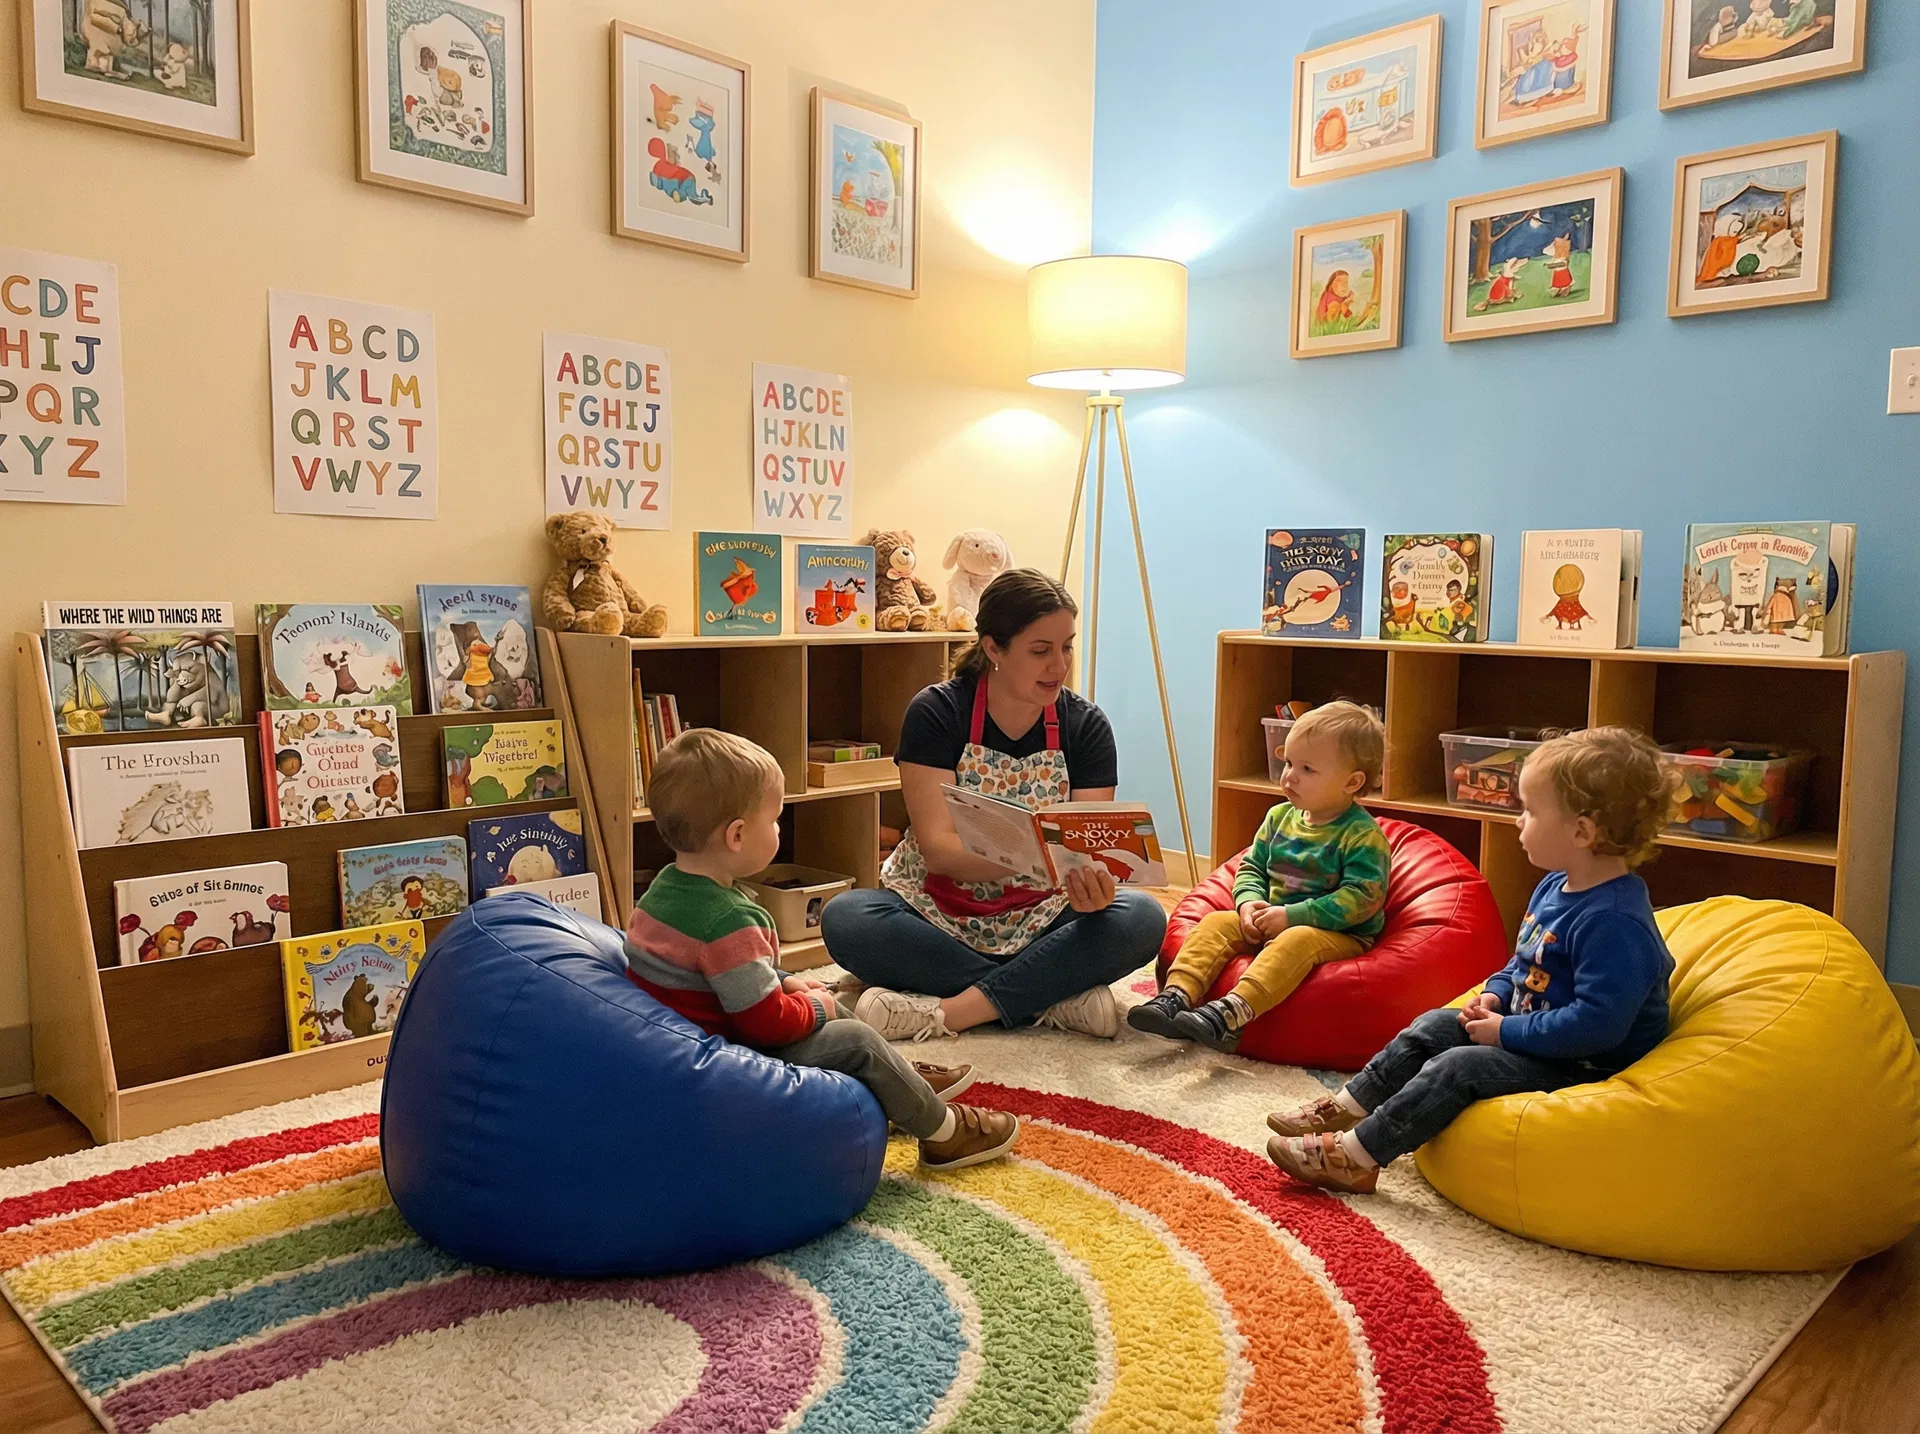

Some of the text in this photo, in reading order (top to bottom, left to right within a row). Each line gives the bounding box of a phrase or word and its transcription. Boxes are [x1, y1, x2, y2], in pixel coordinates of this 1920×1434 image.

[556, 352, 661, 394] ABCDE
[558, 391, 661, 433] FGHIJ
[763, 381, 844, 416] ABCDE
[764, 417, 845, 452] HJKLN
[557, 433, 662, 473] QRSTU
[763, 453, 846, 487] QSTUV
[59, 608, 223, 625] WHERE THE WILD THINGS ARE
[101, 755, 137, 770] The
[1064, 829, 1131, 839] SNOWY
[1083, 838, 1118, 848] DAY
